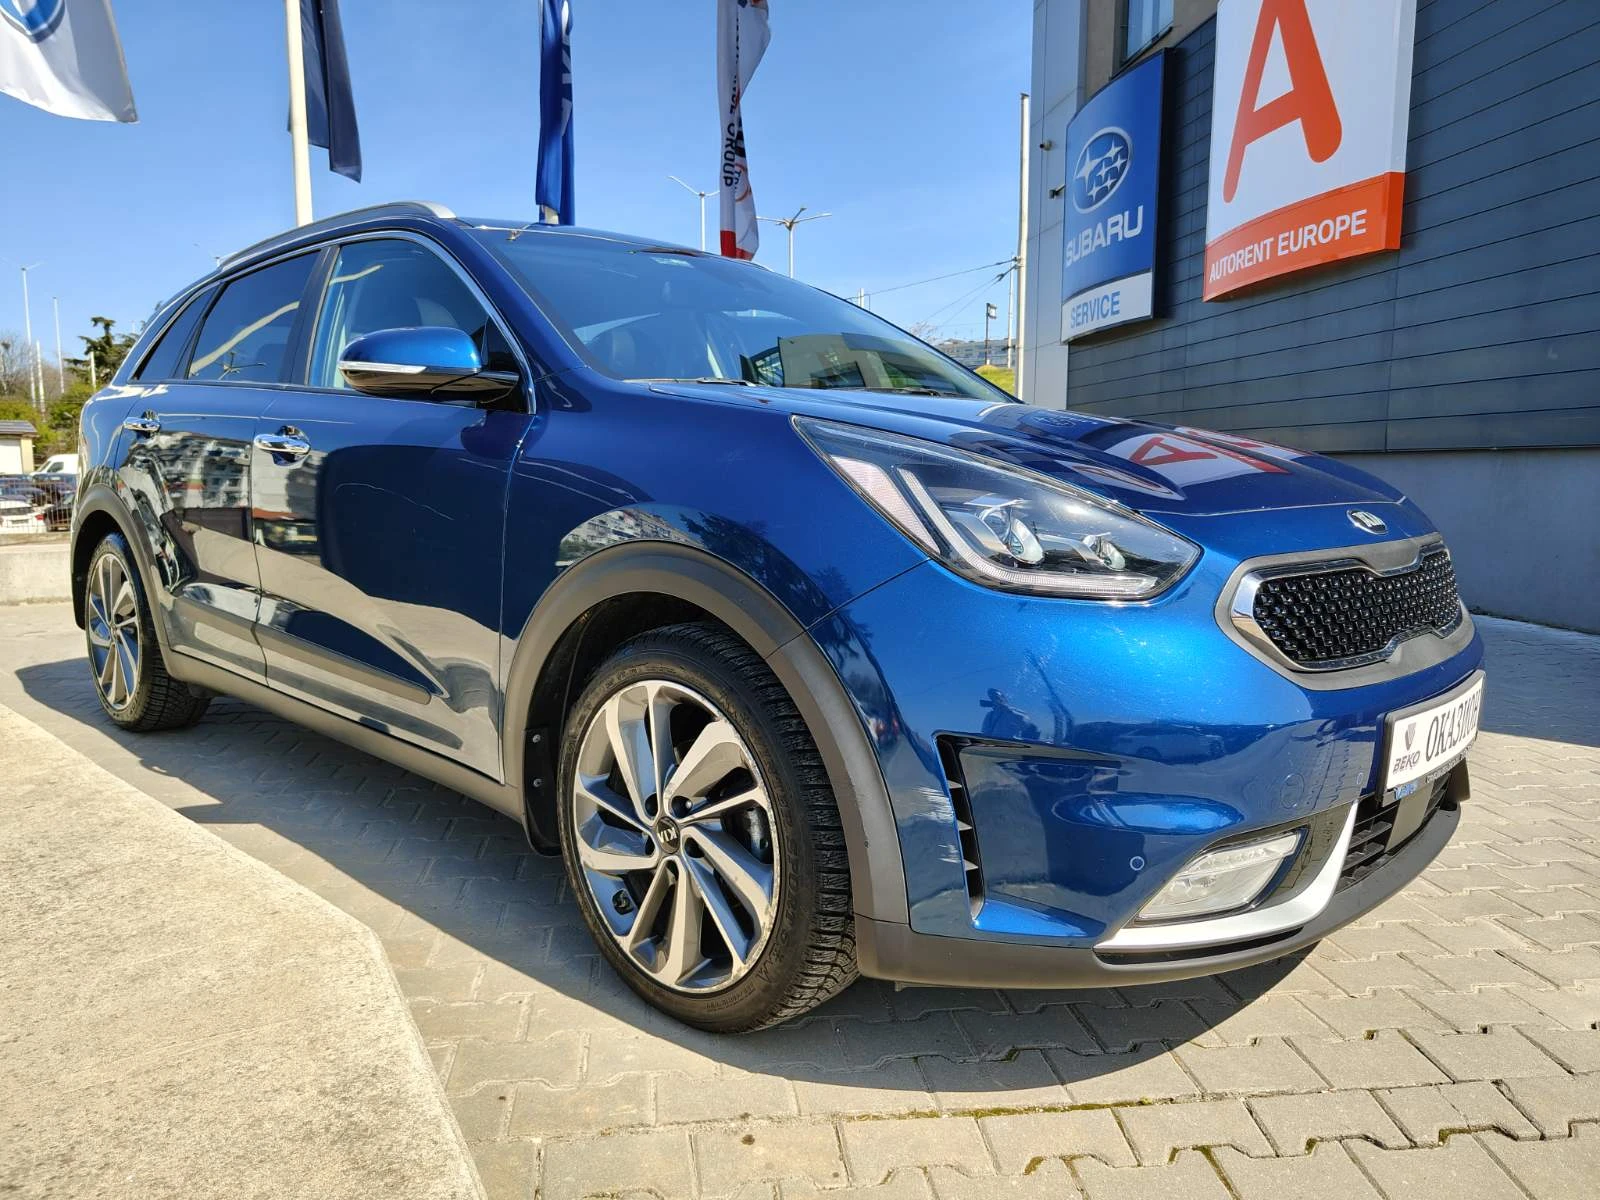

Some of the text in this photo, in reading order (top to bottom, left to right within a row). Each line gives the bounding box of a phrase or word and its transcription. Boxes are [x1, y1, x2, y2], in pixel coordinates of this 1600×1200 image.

[1222, 0, 1343, 204] A
[1065, 205, 1144, 267] SUBARU
[1209, 209, 1367, 282] AUTORENT EUROPE
[1070, 290, 1121, 329] SERVICE
